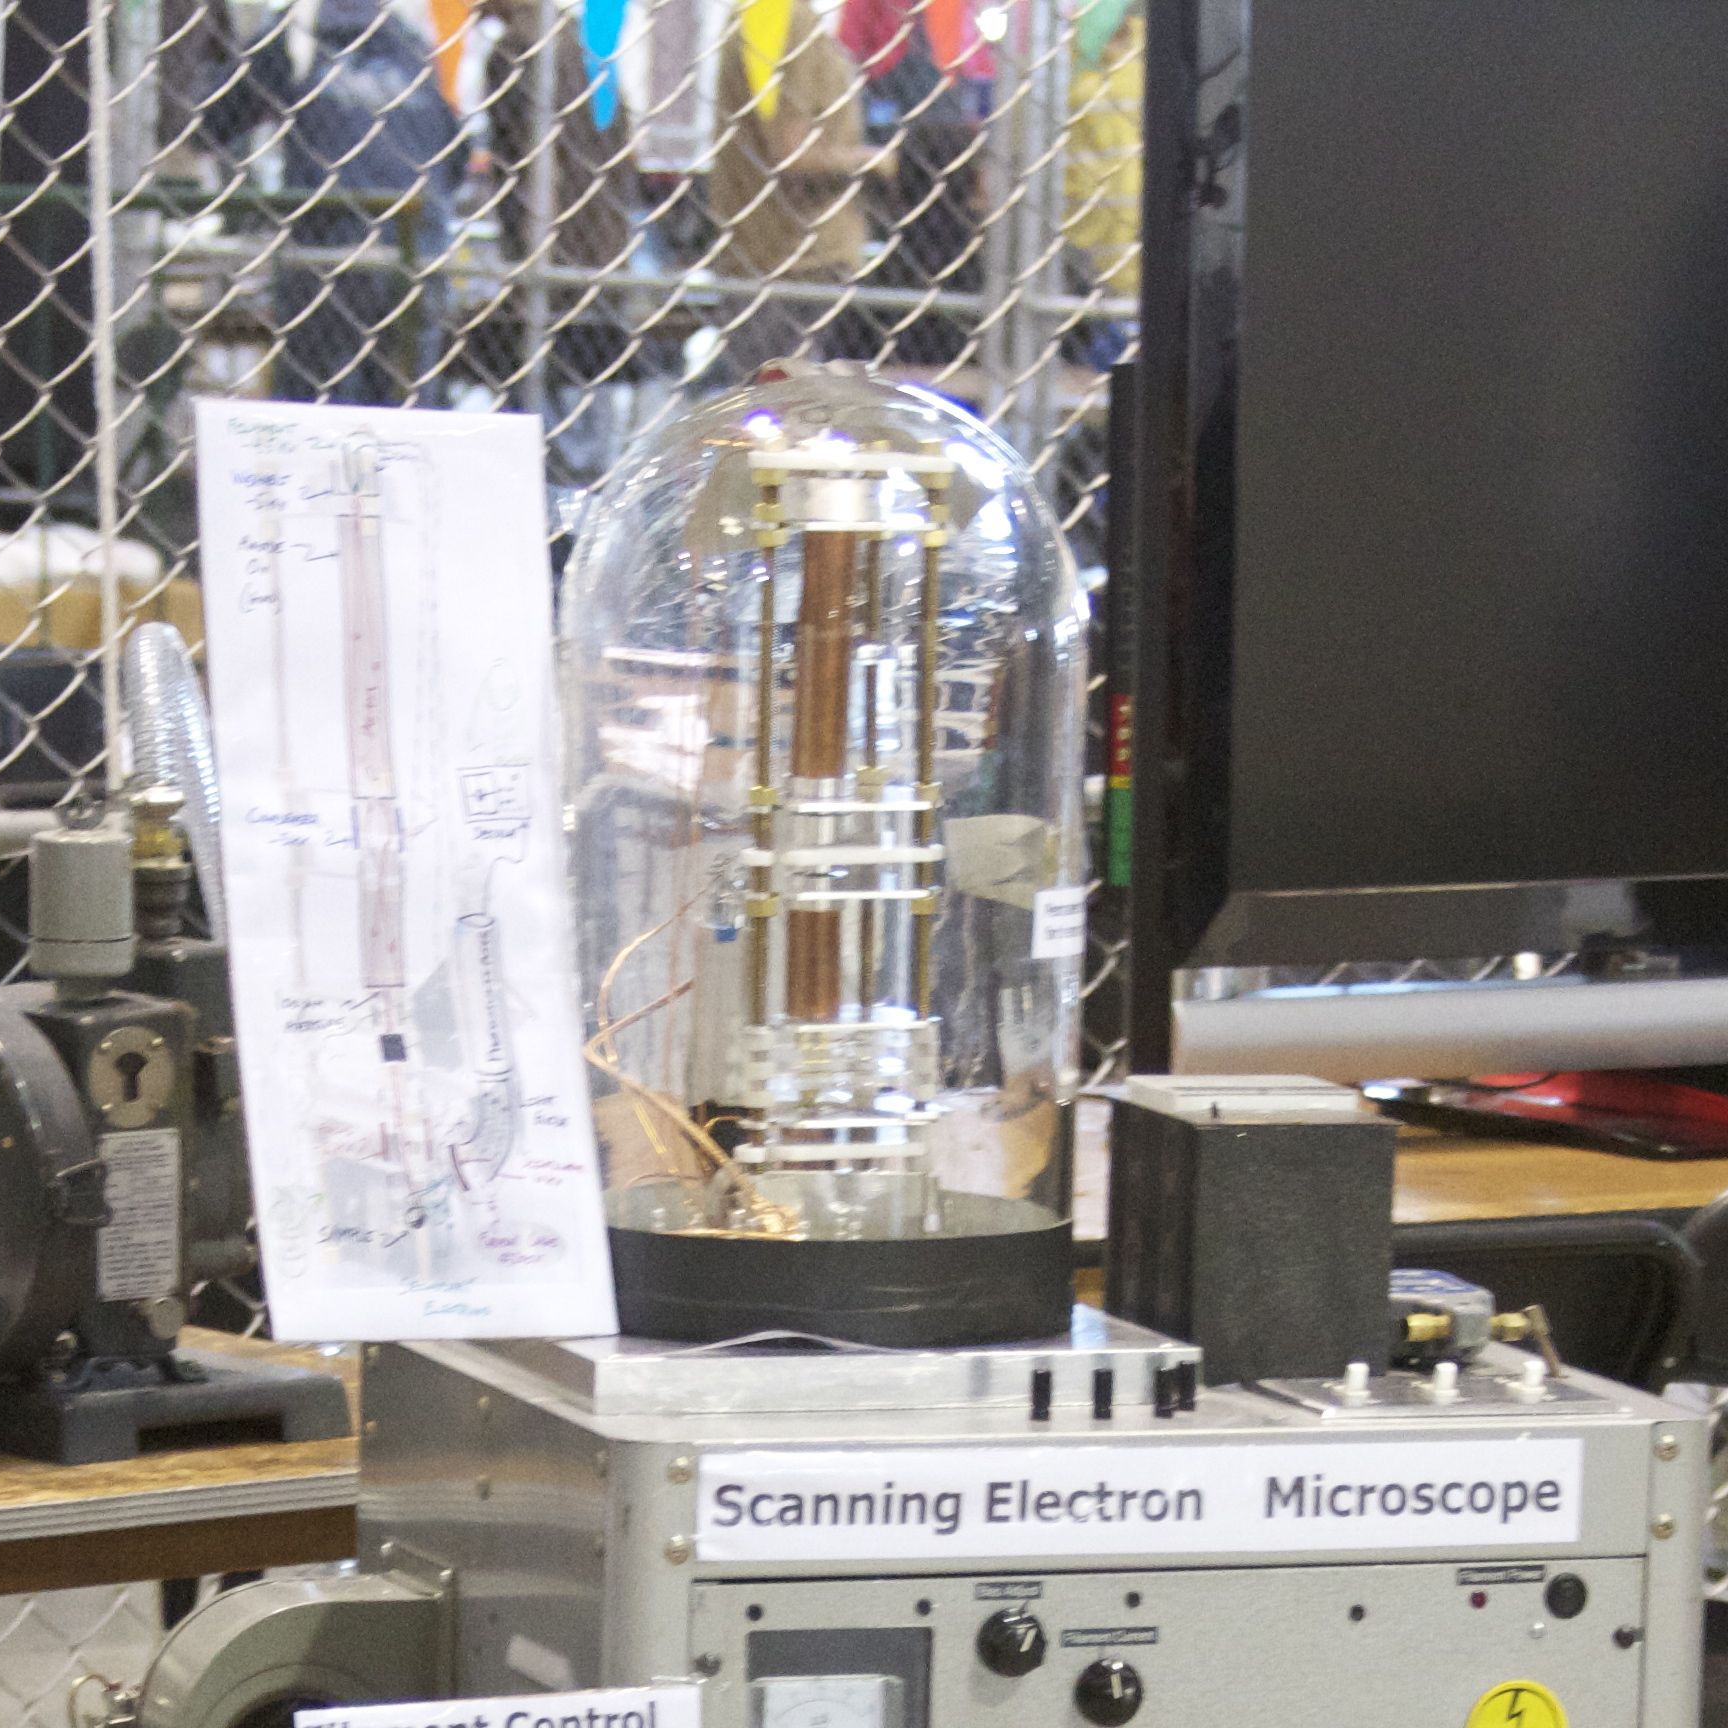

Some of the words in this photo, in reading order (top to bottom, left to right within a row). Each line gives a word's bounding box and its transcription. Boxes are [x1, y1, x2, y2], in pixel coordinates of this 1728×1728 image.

[715, 1482, 962, 1535] Scanning
[986, 1480, 1201, 1522] Electron
[1266, 1474, 1560, 1523] Microscope
